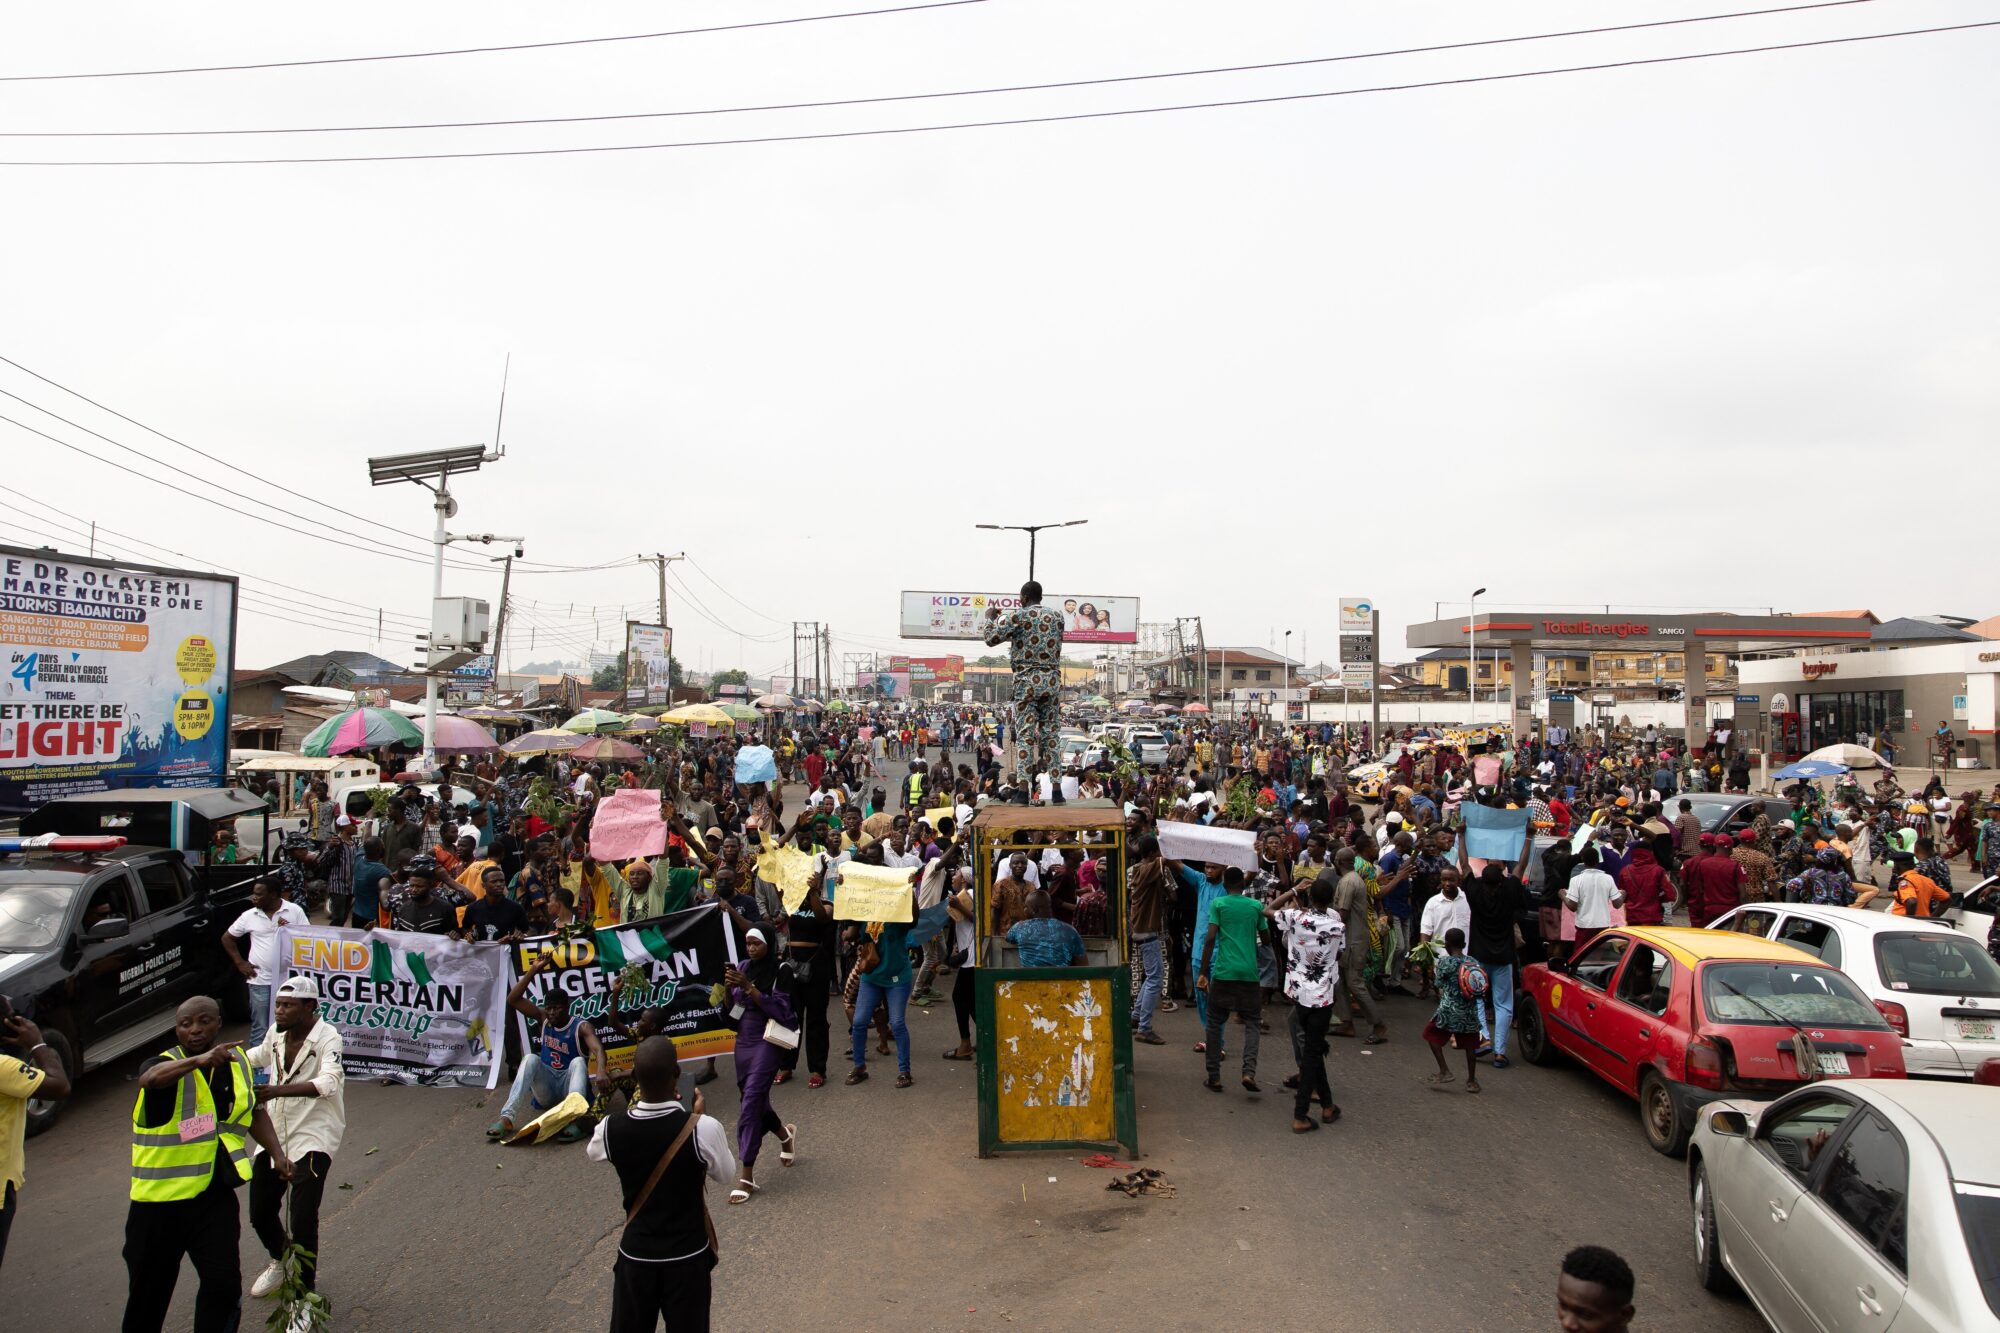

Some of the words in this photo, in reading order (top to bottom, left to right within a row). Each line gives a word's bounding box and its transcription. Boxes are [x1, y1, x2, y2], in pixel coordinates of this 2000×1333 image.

[76, 587, 160, 608] NUMBER
[167, 598, 203, 610] ONE
[932, 596, 971, 607] KIDZ
[975, 598, 985, 606] &
[988, 599, 1021, 608] MOR
[0, 595, 57, 613] STORMS
[61, 601, 111, 619] IBADAN
[113, 607, 142, 621] CITY
[2, 615, 35, 625] SANGO
[37, 618, 60, 628] POLY
[61, 620, 88, 631] ROAD,
[1542, 619, 1649, 638] TotalEnergies
[1657, 627, 1685, 635] SANGO
[18, 625, 82, 638] HANDICAPPED
[84, 630, 124, 641] CHILDREN
[126, 633, 147, 643] FIELD
[28, 635, 54, 646] WAEC
[56, 638, 85, 648] OFFICE
[87, 640, 121, 650] IBADAN.
[11, 651, 25, 663] in
[39, 653, 59, 663] DAYS
[12, 652, 38, 691] 4
[38, 663, 61, 673] GREAT
[64, 665, 81, 674] HOLY
[83, 666, 107, 675] GHOST
[1802, 660, 1838, 676] bonjour
[38, 673, 69, 683] REVIVAL
[70, 675, 76, 683] &
[77, 674, 108, 684] MIRACLE
[45, 691, 76, 700] THEME:
[1771, 699, 1785, 710] café
[32, 704, 95, 719] THERE
[100, 704, 122, 719] BE
[196, 712, 210, 721] 8PM
[181, 722, 187, 730] &
[188, 721, 205, 730] 10PM
[0, 721, 122, 758] LIGHT
[97, 762, 136, 771] EMPOWERMENT
[25, 773, 57, 781] MINISTERS
[57, 770, 100, 779] EMPOWERMENT
[291, 936, 370, 973] END
[519, 937, 597, 973] END
[119, 963, 145, 983] NIGERIA
[145, 953, 165, 972] POLICE
[165, 945, 182, 962] FORCE
[517, 948, 701, 1000] NIGEAN
[687, 1006, 723, 1018] #Electric
[661, 1021, 698, 1033] nsecurity
[338, 1030, 378, 1042] ndInflation
[380, 1034, 421, 1048] #BorderLock
[422, 1041, 465, 1051] #Electricity
[351, 1040, 392, 1051] #Education
[695, 1035, 724, 1045] FEBRUARY
[342, 1060, 367, 1069] MOKOLA,
[368, 1061, 404, 1072] ROUNDABOUT
[550, 1052, 565, 1069] 3
[346, 1067, 371, 1075] ARRIVAL
[179, 1113, 214, 1132] SECURITY
